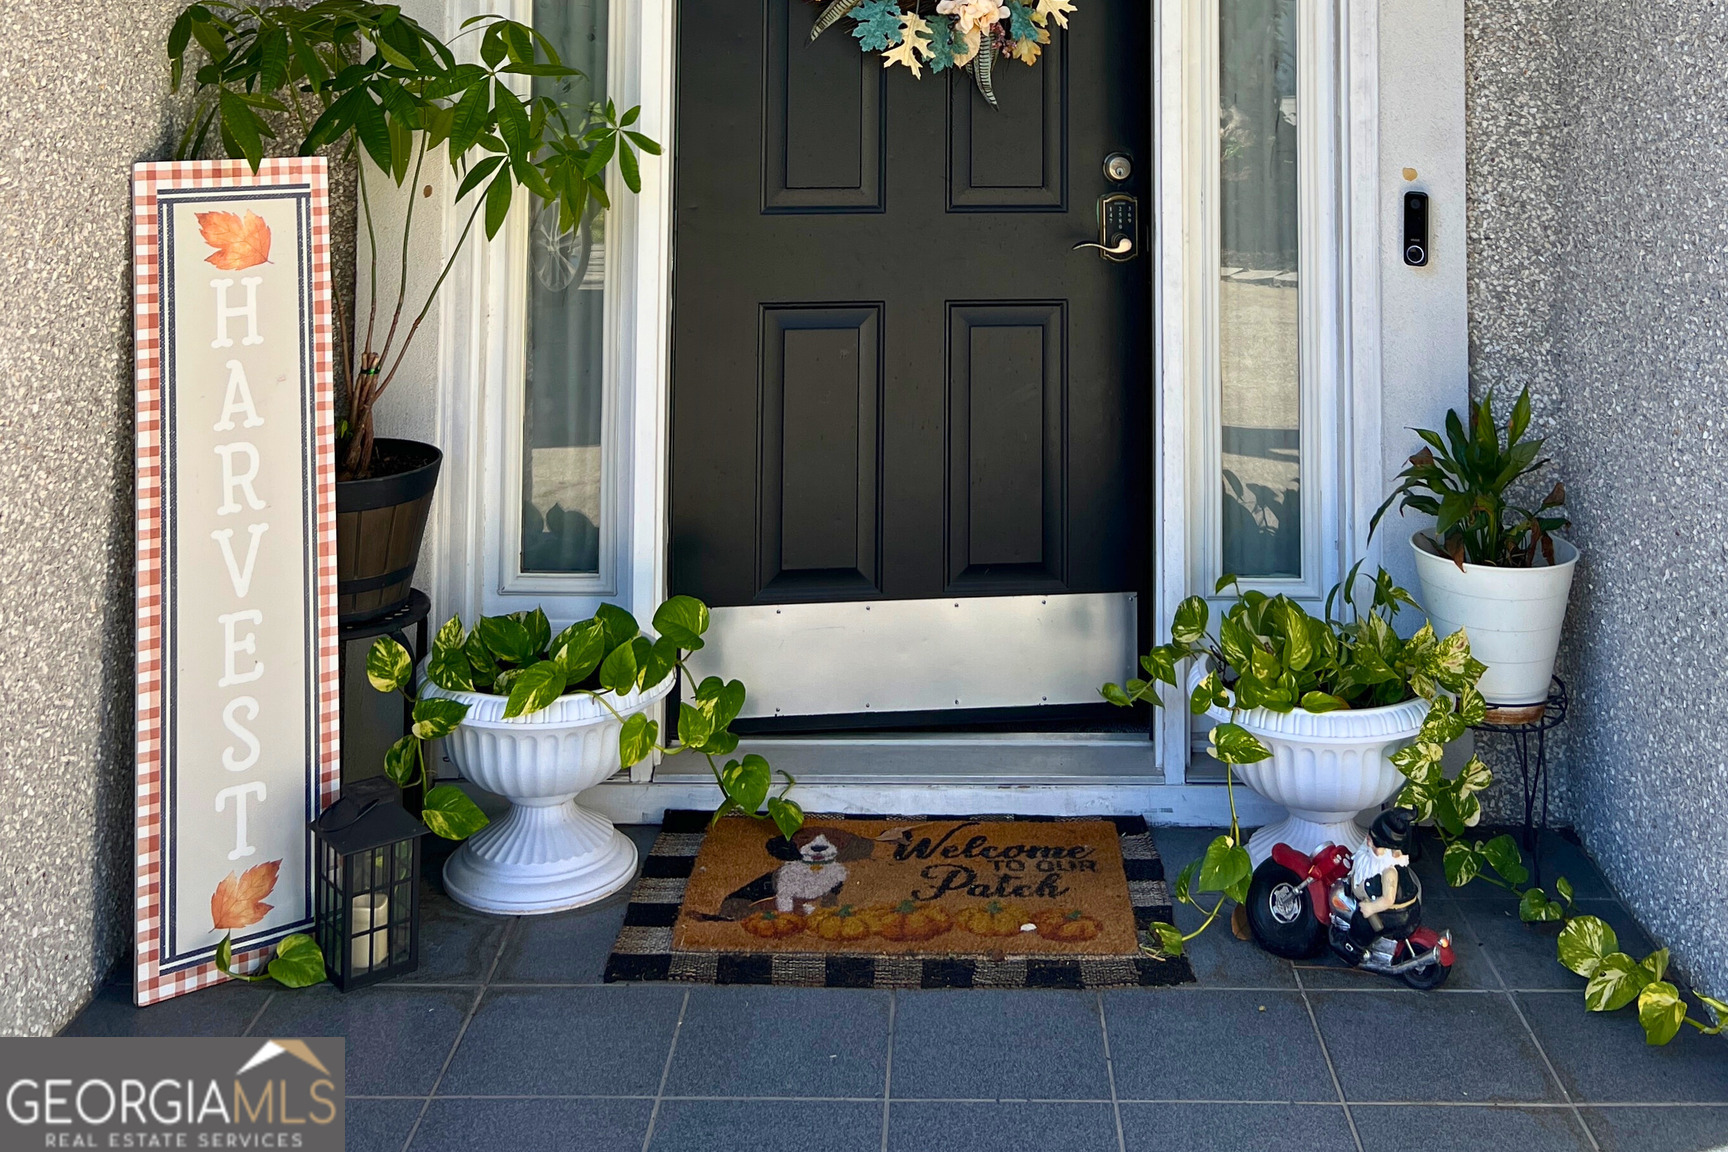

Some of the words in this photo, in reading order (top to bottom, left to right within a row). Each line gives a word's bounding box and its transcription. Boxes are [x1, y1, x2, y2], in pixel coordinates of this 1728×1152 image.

[210, 276, 269, 861] HARVEST
[892, 821, 1096, 861] Welcome
[911, 863, 1070, 902] Patch
[987, 859, 1025, 873] TO
[1036, 859, 1098, 873] OUR
